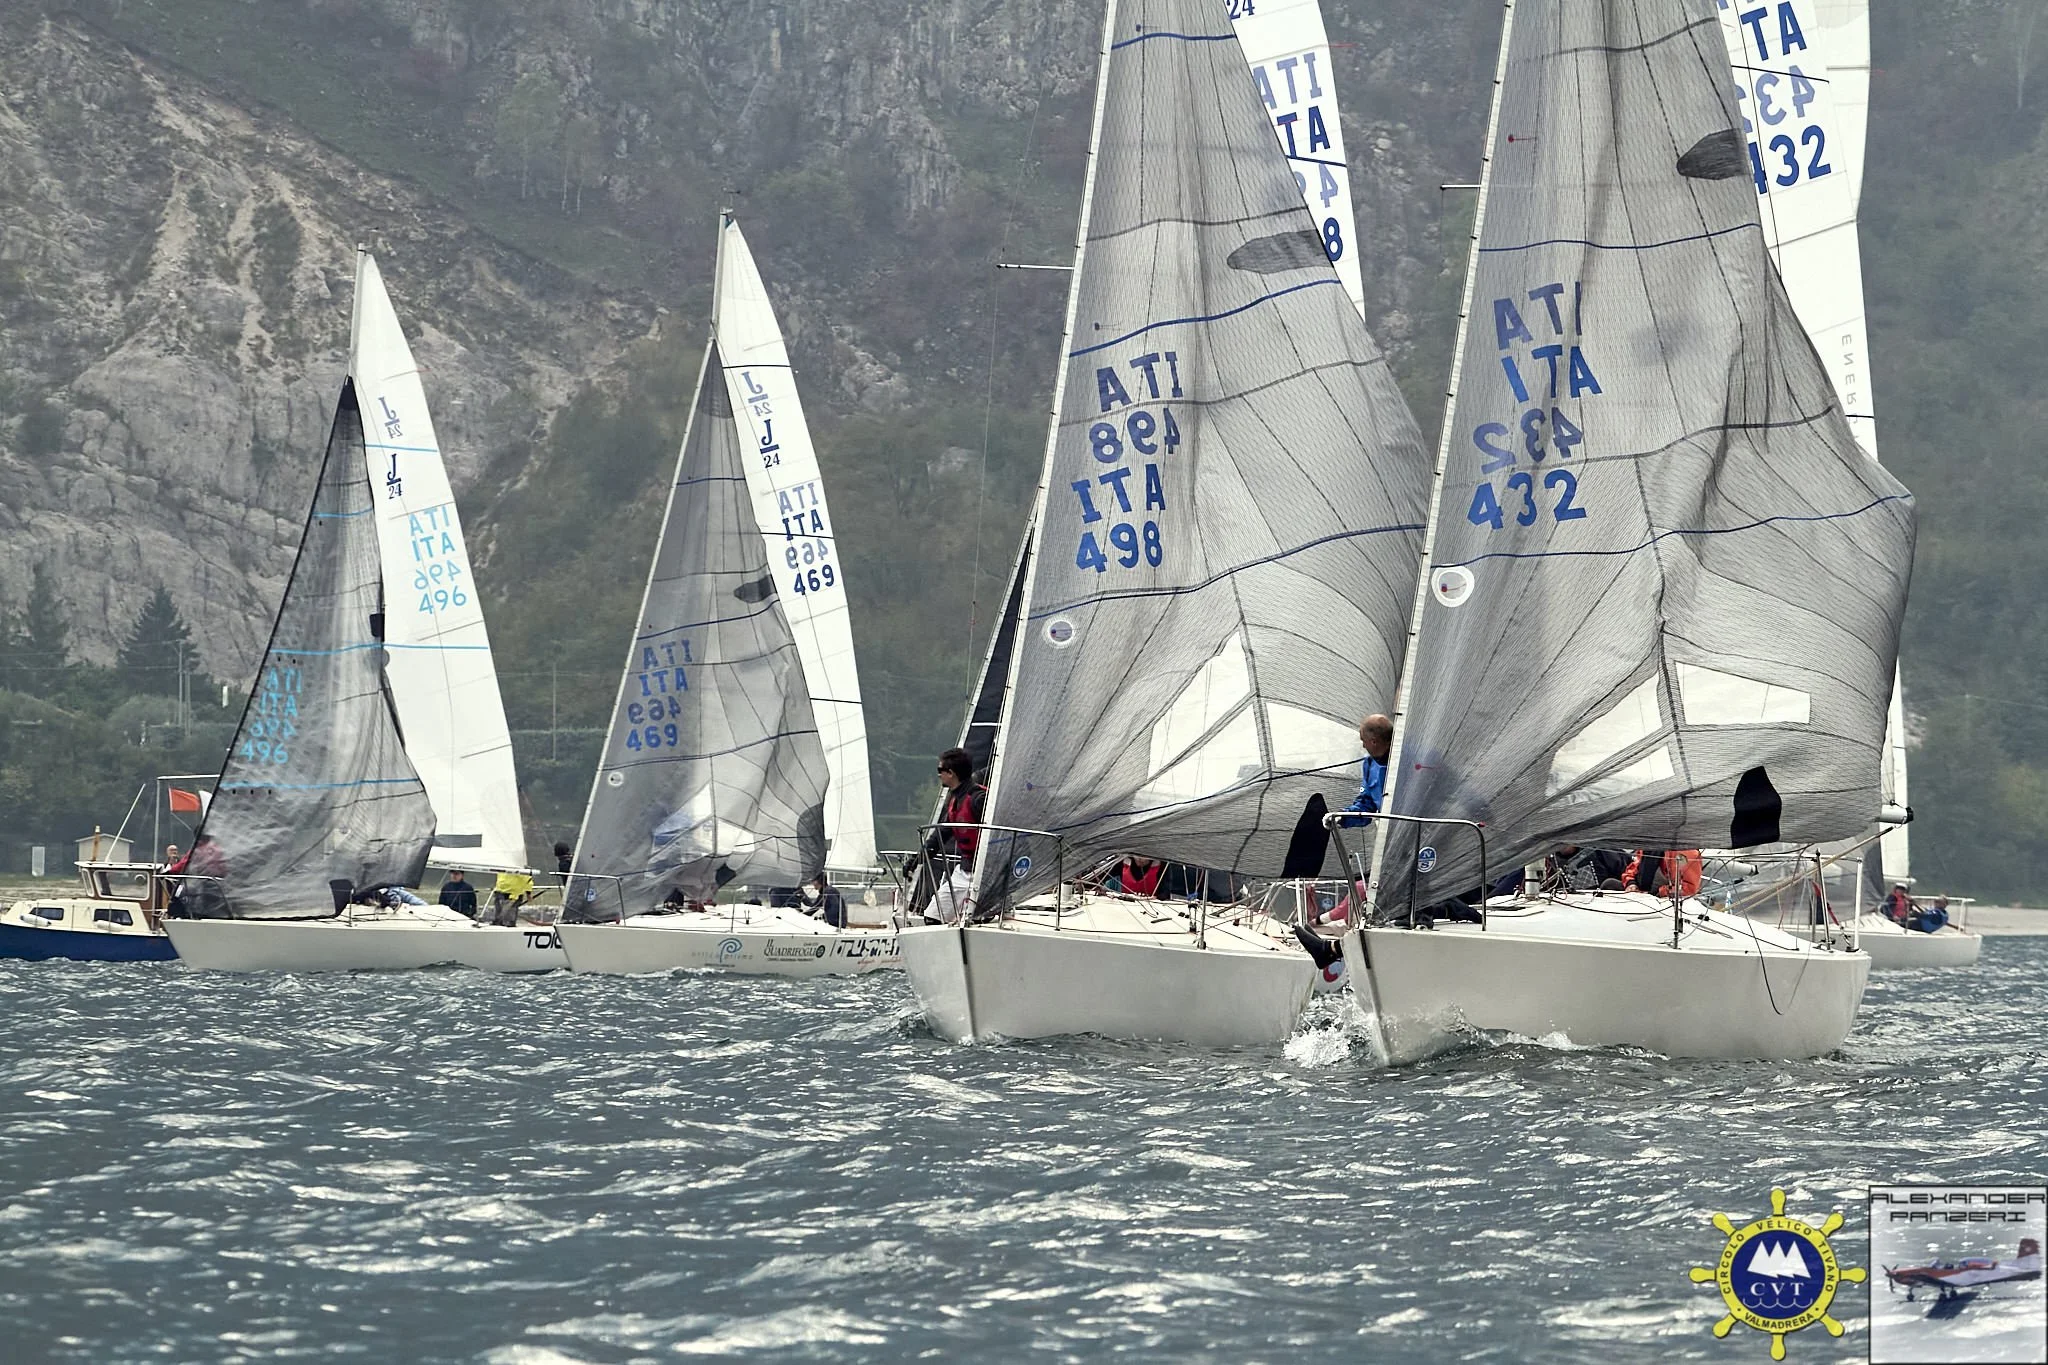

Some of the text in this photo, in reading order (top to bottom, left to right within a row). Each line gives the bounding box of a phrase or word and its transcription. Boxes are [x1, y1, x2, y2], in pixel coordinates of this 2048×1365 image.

[1740, 1, 1807, 61] TA
[1276, 105, 1331, 161] TA
[1501, 344, 1602, 403] ITA
[760, 418, 773, 446] J
[763, 452, 780, 469] 24
[388, 483, 403, 500] 24
[1071, 463, 1166, 524] ITA
[1467, 469, 1587, 530] 432
[782, 509, 824, 541] ITA
[412, 531, 455, 562] ITA
[1075, 520, 1163, 573] 498
[794, 564, 835, 596] 469
[419, 585, 467, 615] 496
[639, 667, 688, 697] ITA
[259, 691, 298, 717] ITA
[240, 739, 289, 764] 496
[626, 723, 678, 752] 469
